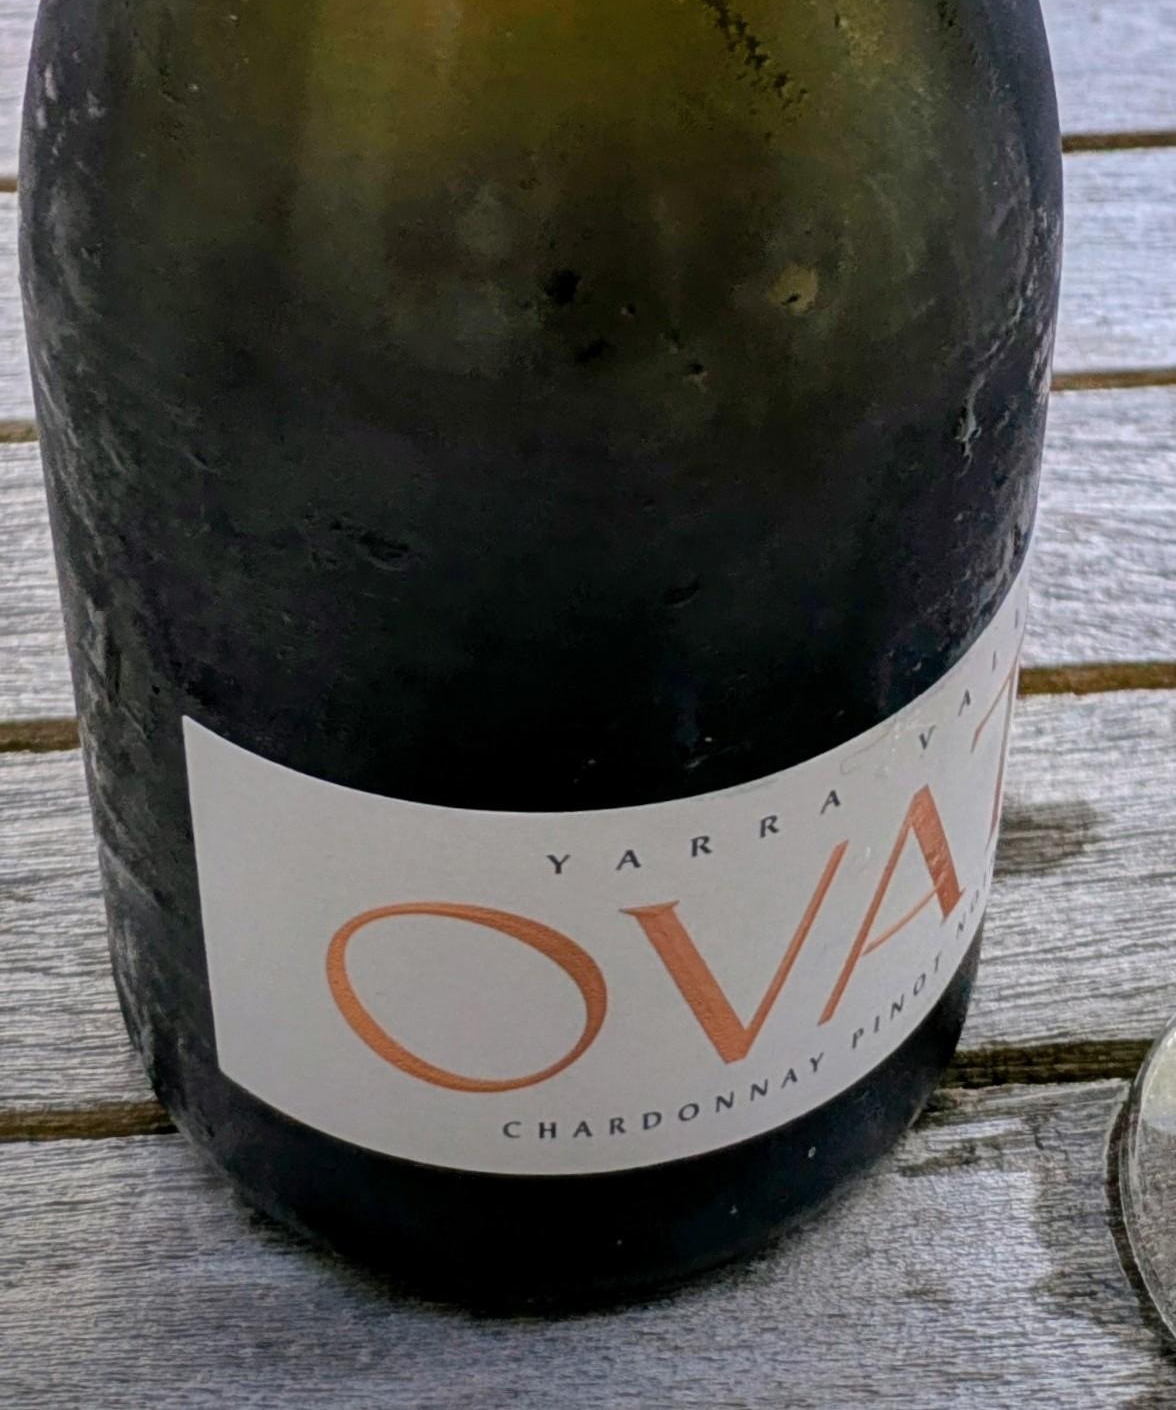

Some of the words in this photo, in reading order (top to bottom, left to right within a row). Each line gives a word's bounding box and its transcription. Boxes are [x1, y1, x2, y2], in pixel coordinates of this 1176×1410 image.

[546, 789, 842, 876] YARRA
[501, 1052, 826, 1140] CHARDONNAY
[851, 949, 943, 1050] PINOT
